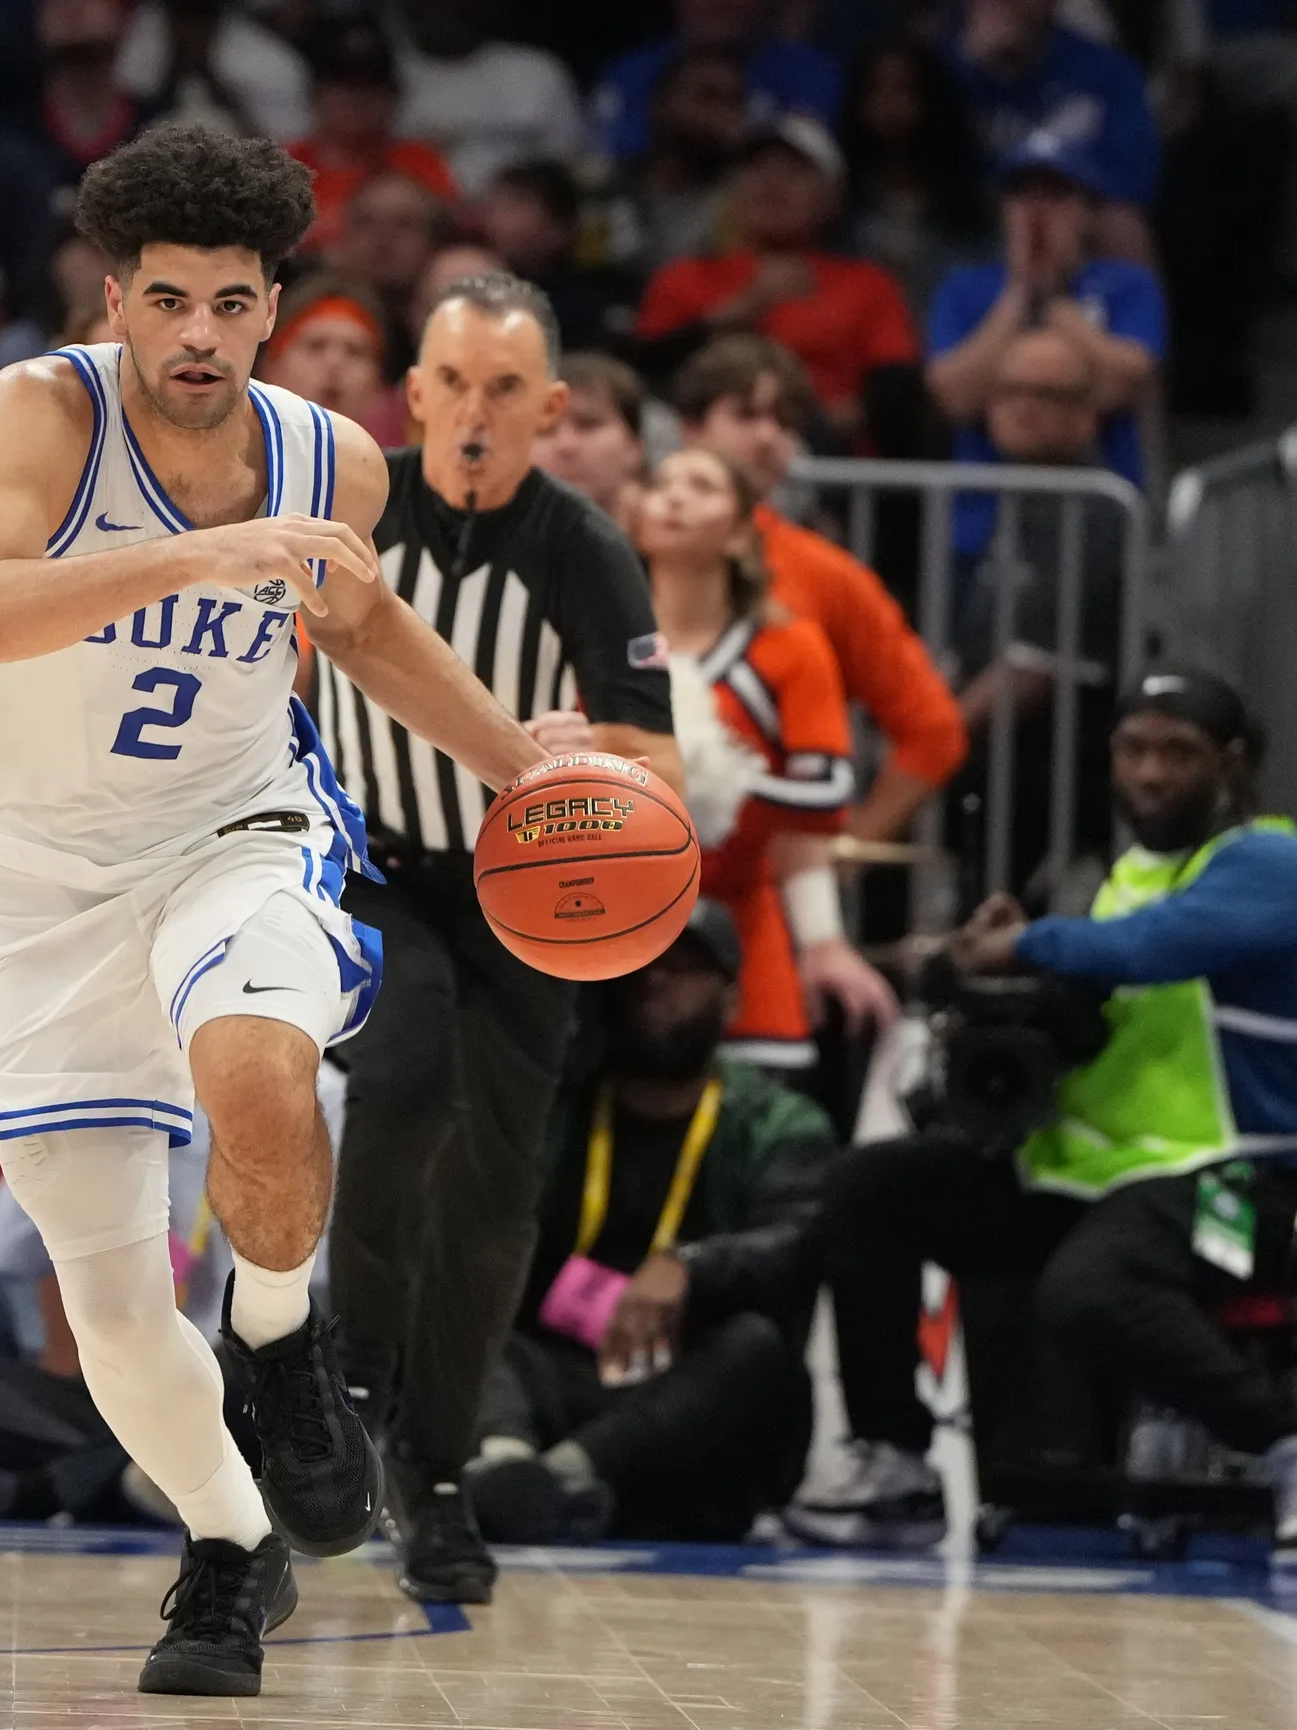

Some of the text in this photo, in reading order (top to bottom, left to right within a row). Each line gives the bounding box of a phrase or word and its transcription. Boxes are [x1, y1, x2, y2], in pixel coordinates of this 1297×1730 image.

[110, 667, 202, 760] 2
[507, 798, 634, 832] LEGACY
[544, 819, 623, 835] 1000
[538, 832, 603, 847] OFFICIAL GAME BALL
